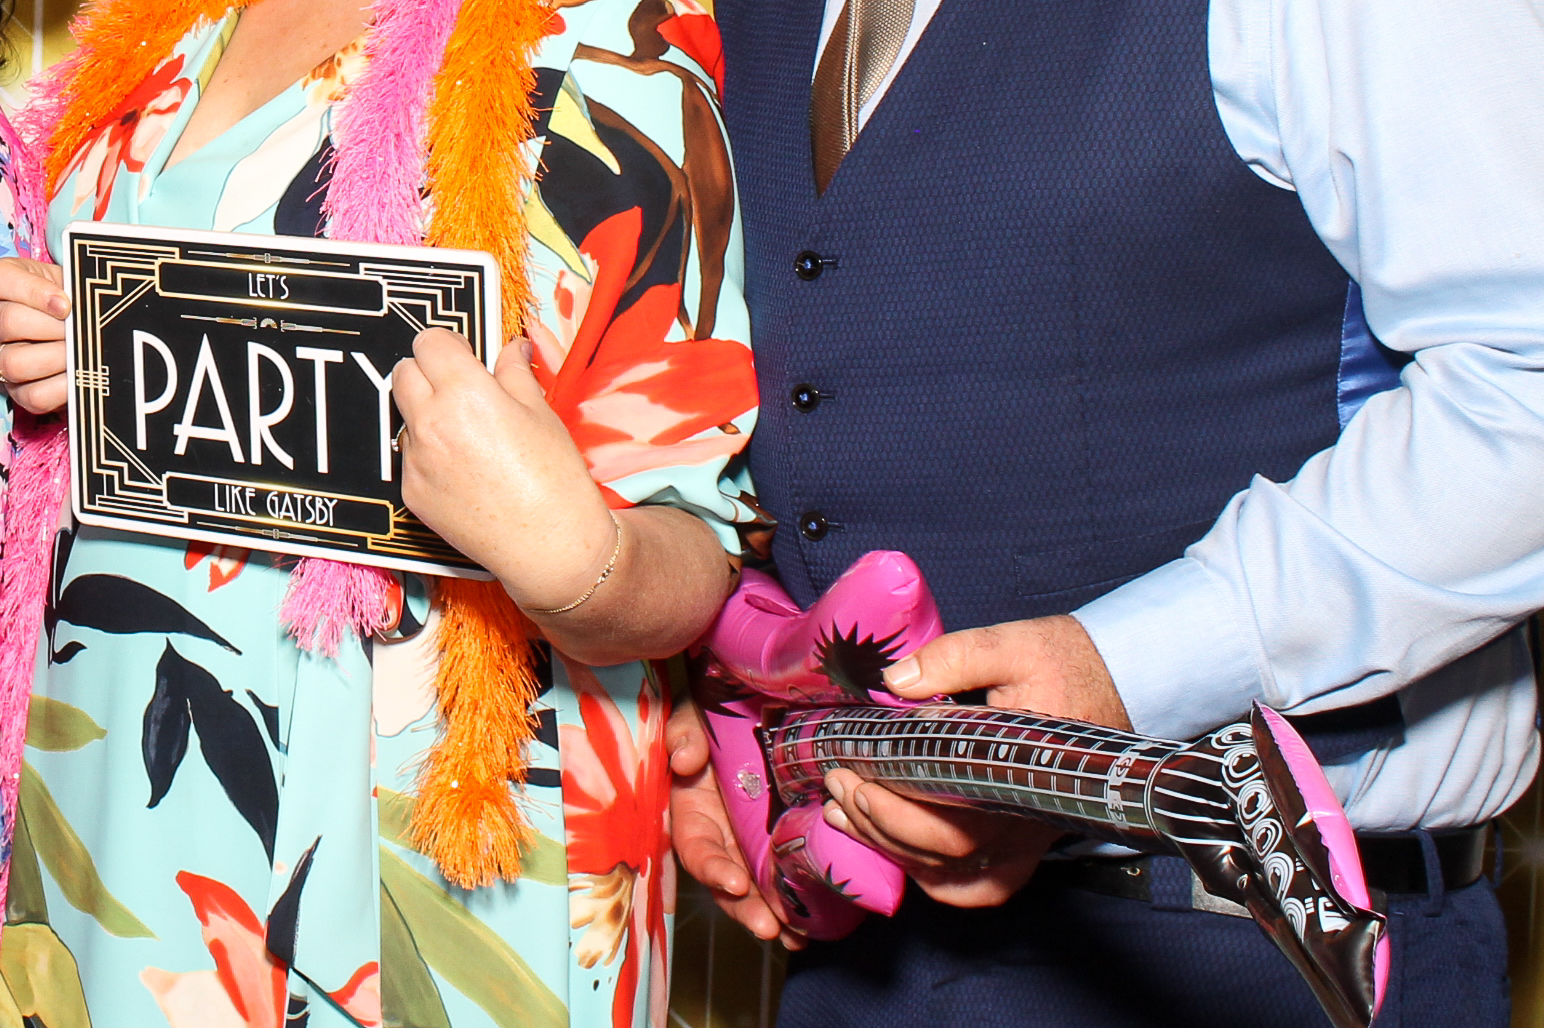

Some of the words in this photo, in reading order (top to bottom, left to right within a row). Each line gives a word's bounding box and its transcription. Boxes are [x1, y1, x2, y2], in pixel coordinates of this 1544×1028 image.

[248, 273, 289, 300] LET'S
[132, 329, 393, 482] PARTY
[214, 483, 257, 516] LIKE
[266, 492, 338, 527] GATSBY
